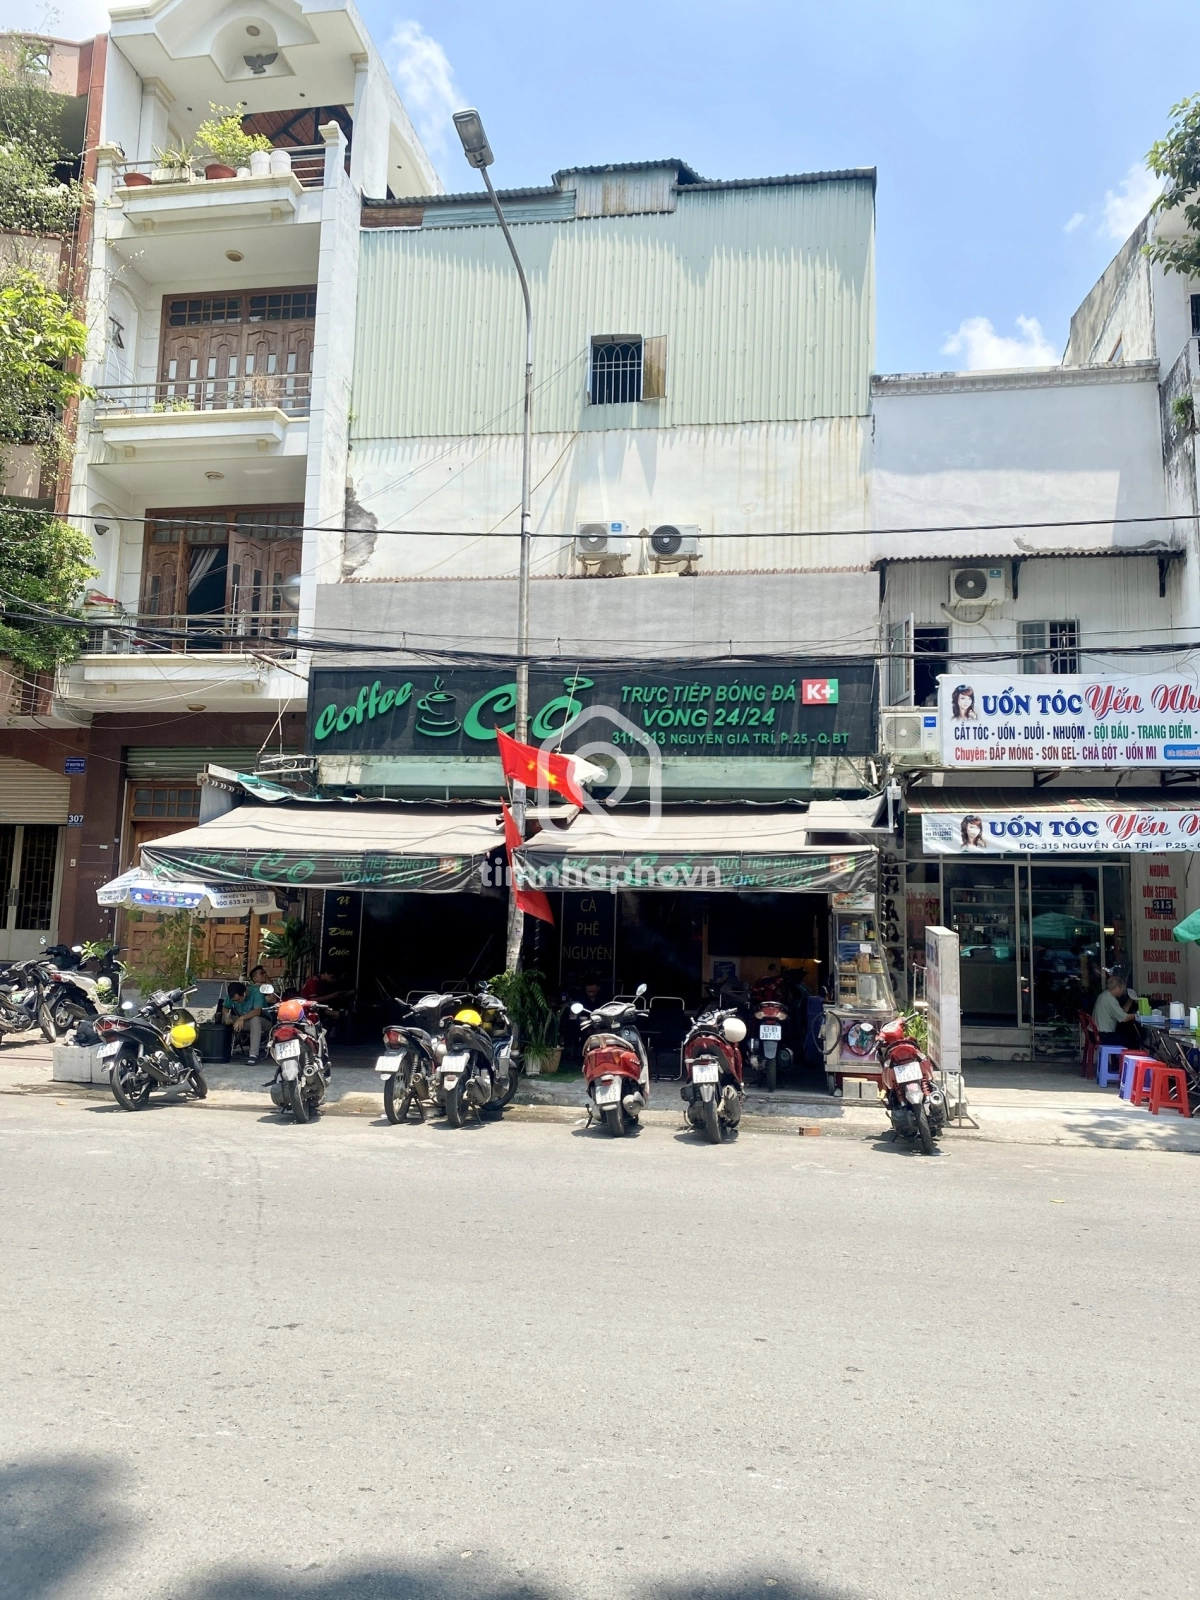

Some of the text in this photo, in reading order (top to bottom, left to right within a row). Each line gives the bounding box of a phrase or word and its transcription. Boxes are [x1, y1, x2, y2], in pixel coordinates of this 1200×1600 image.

[621, 680, 834, 706] TRỰC TIẾP BÓNG ĐÁ K+
[982, 686, 1031, 716] UỐN
[1037, 689, 1083, 715] TÓC
[1085, 684, 1144, 720] Yến
[314, 680, 414, 741] Coffee
[642, 703, 775, 727] VÕNG 24/24
[612, 731, 666, 745] 311-313
[727, 733, 750, 744] GIA
[954, 719, 1192, 743] CẮT TÓC UỐN DUỖI NHUỘM GỘI ĐẦU TRANG ĐIỂM
[955, 746, 988, 762] Chuyên:
[989, 741, 1006, 761] ĐẮP
[1008, 744, 1033, 760] MÓNG
[1042, 745, 1059, 760] SƠN
[1082, 743, 1099, 760] CHÀ
[1102, 743, 1117, 760] GÓT
[1125, 741, 1143, 760] UỐN
[1146, 745, 1157, 760] MI
[68, 815, 84, 823] 307
[989, 814, 1043, 838] UỐN
[1048, 816, 1099, 838] TÓC
[1105, 813, 1171, 841] Yến
[1042, 842, 1059, 850] 315
[1062, 840, 1109, 849] NGUYỄN
[1135, 841, 1153, 849] TRÍ
[580, 896, 597, 912] CÀ
[1153, 901, 1172, 910] 315
[576, 920, 600, 936] PHÊ
